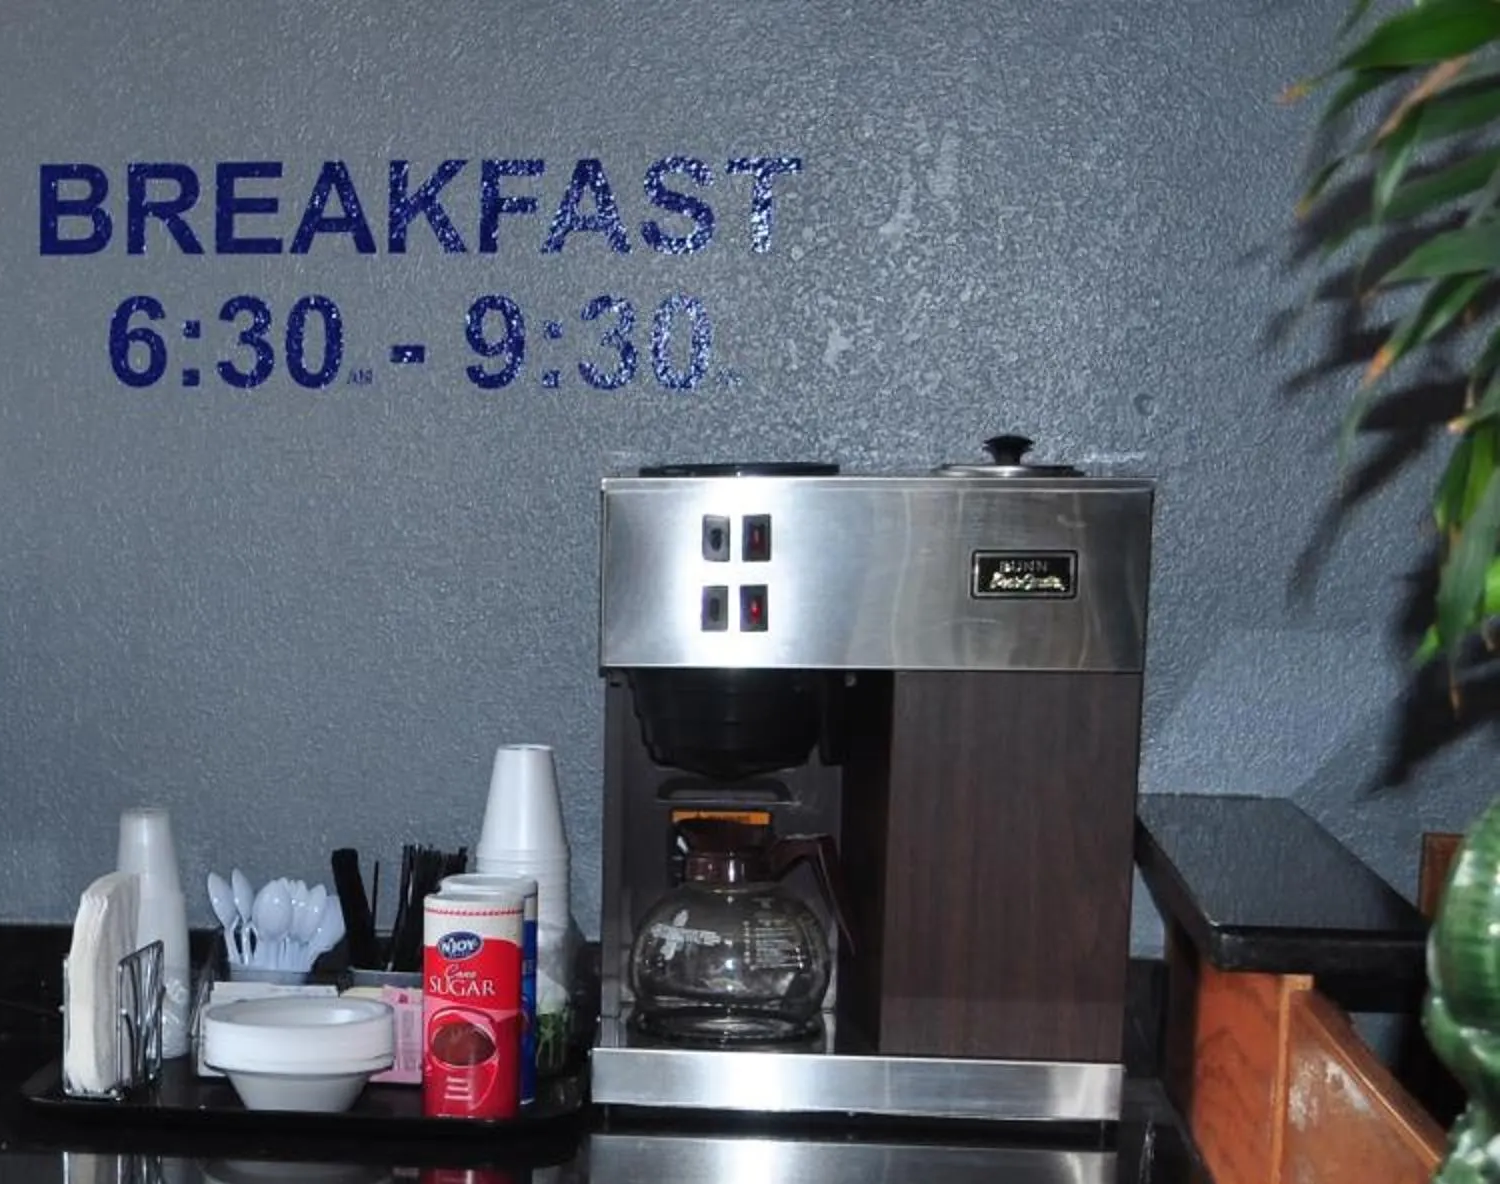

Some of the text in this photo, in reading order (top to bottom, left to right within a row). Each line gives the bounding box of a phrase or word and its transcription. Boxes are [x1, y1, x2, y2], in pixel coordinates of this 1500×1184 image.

[39, 156, 802, 256] BREAKFAST
[109, 295, 344, 389] 6:30
[390, 344, 426, 364] -
[464, 294, 713, 391] 9:30
[429, 975, 496, 997] SUGAR
